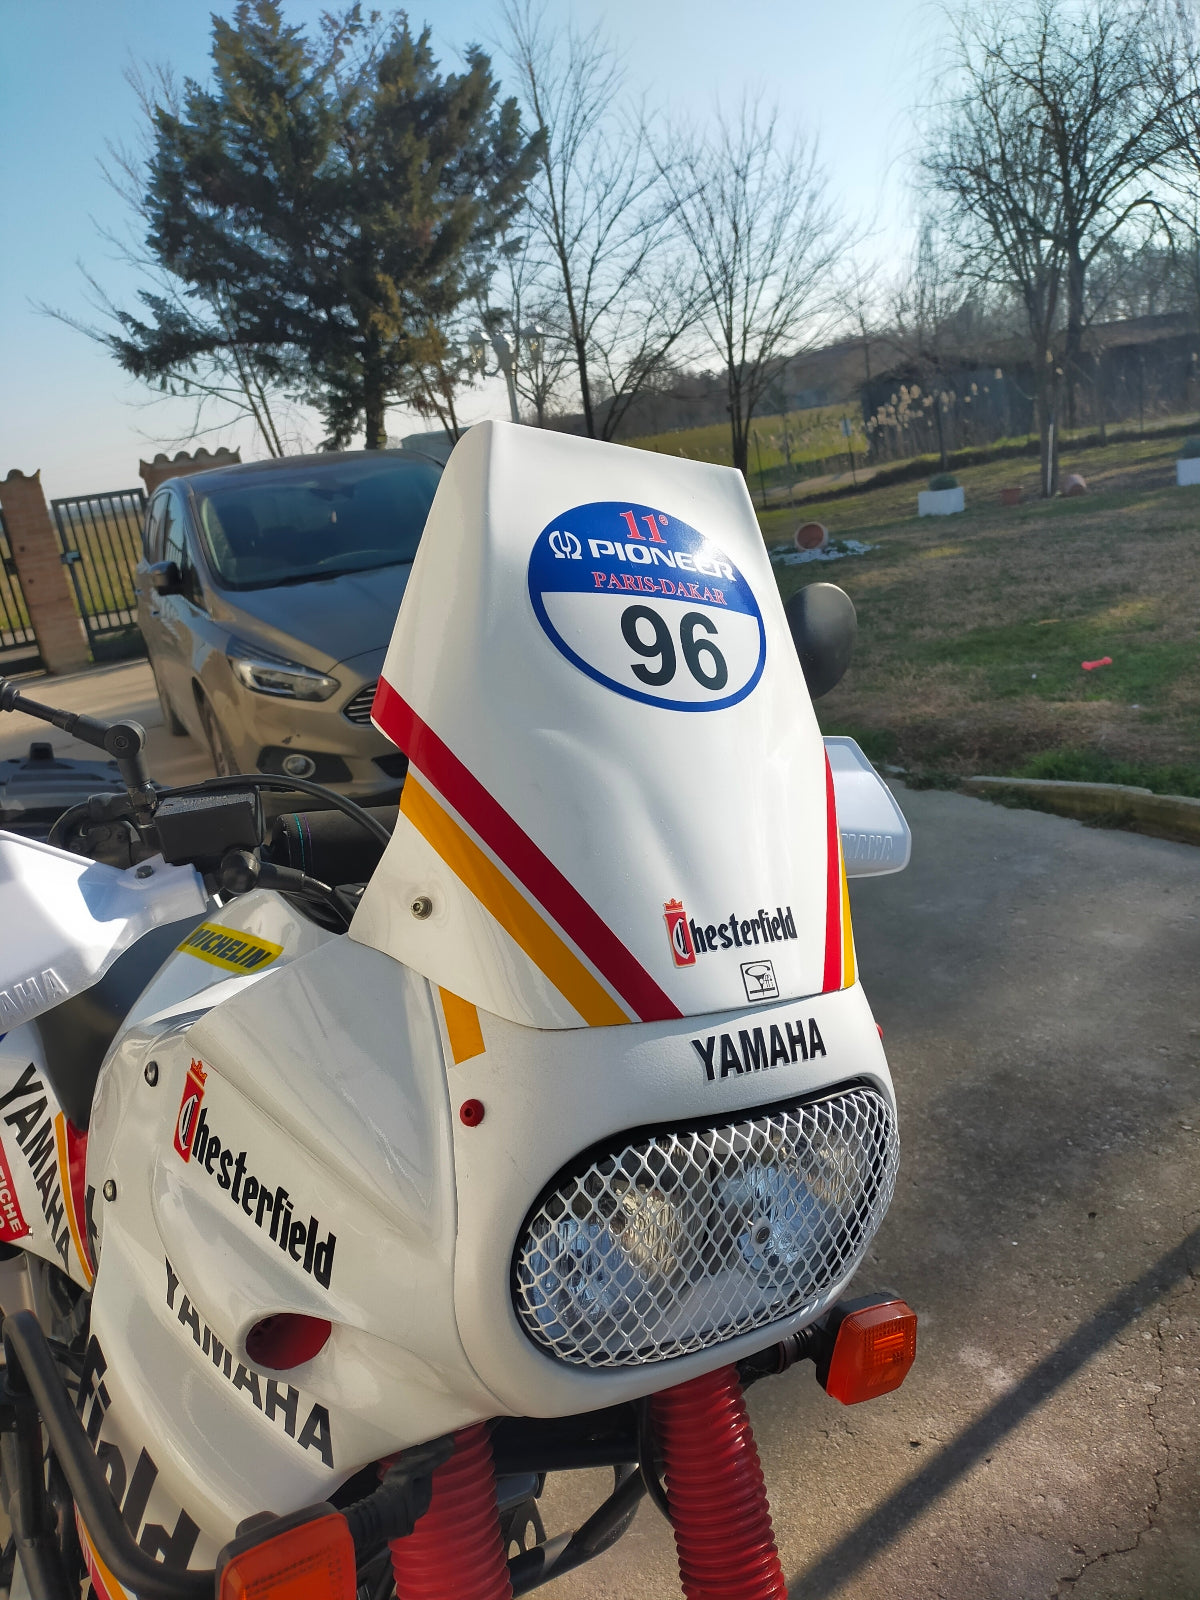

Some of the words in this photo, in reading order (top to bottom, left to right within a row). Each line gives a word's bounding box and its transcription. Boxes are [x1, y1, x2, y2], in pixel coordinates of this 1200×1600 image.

[591, 571, 727, 605] PARIS-DAKAR
[621, 604, 728, 691] 96
[672, 906, 798, 960] Chesterfield
[692, 1017, 827, 1081] YAMAHA
[0, 1062, 70, 1275] YAMAHA
[177, 1093, 337, 1290] Chesterfield
[165, 1255, 335, 1470] YAMAHA
